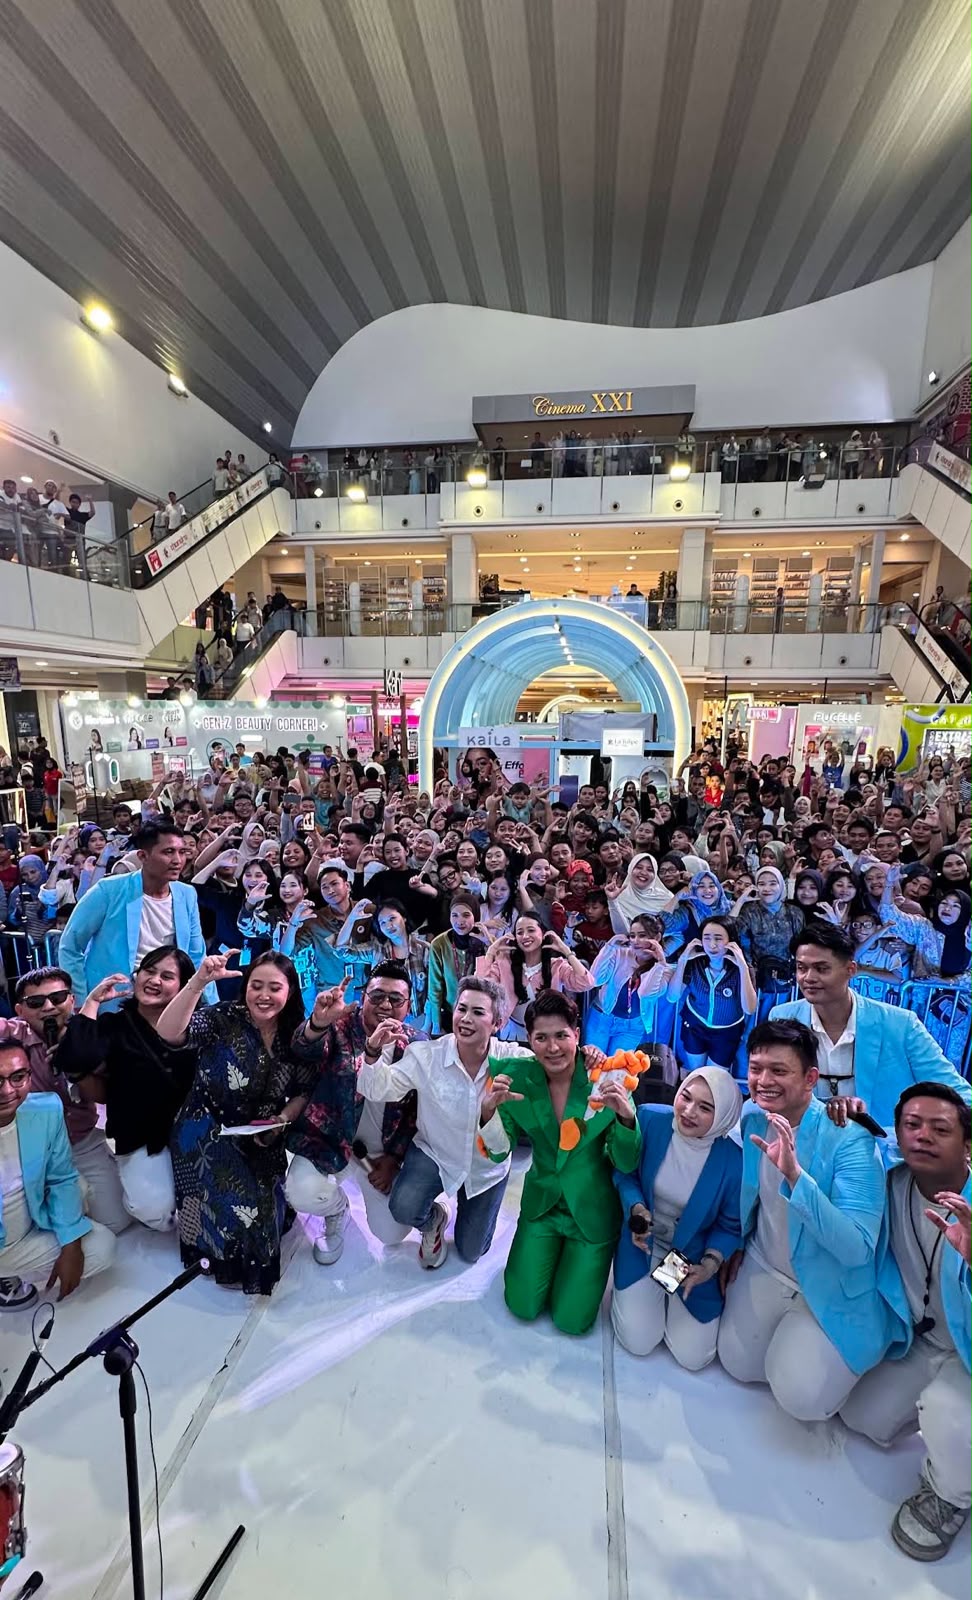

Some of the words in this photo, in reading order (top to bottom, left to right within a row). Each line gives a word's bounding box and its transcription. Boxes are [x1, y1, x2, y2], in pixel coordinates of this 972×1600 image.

[532, 396, 587, 416] Cinema
[591, 391, 634, 413] XXI
[203, 716, 232, 730] GEN-Z
[236, 717, 271, 731] BEAUTY
[277, 717, 318, 731] CORNER!
